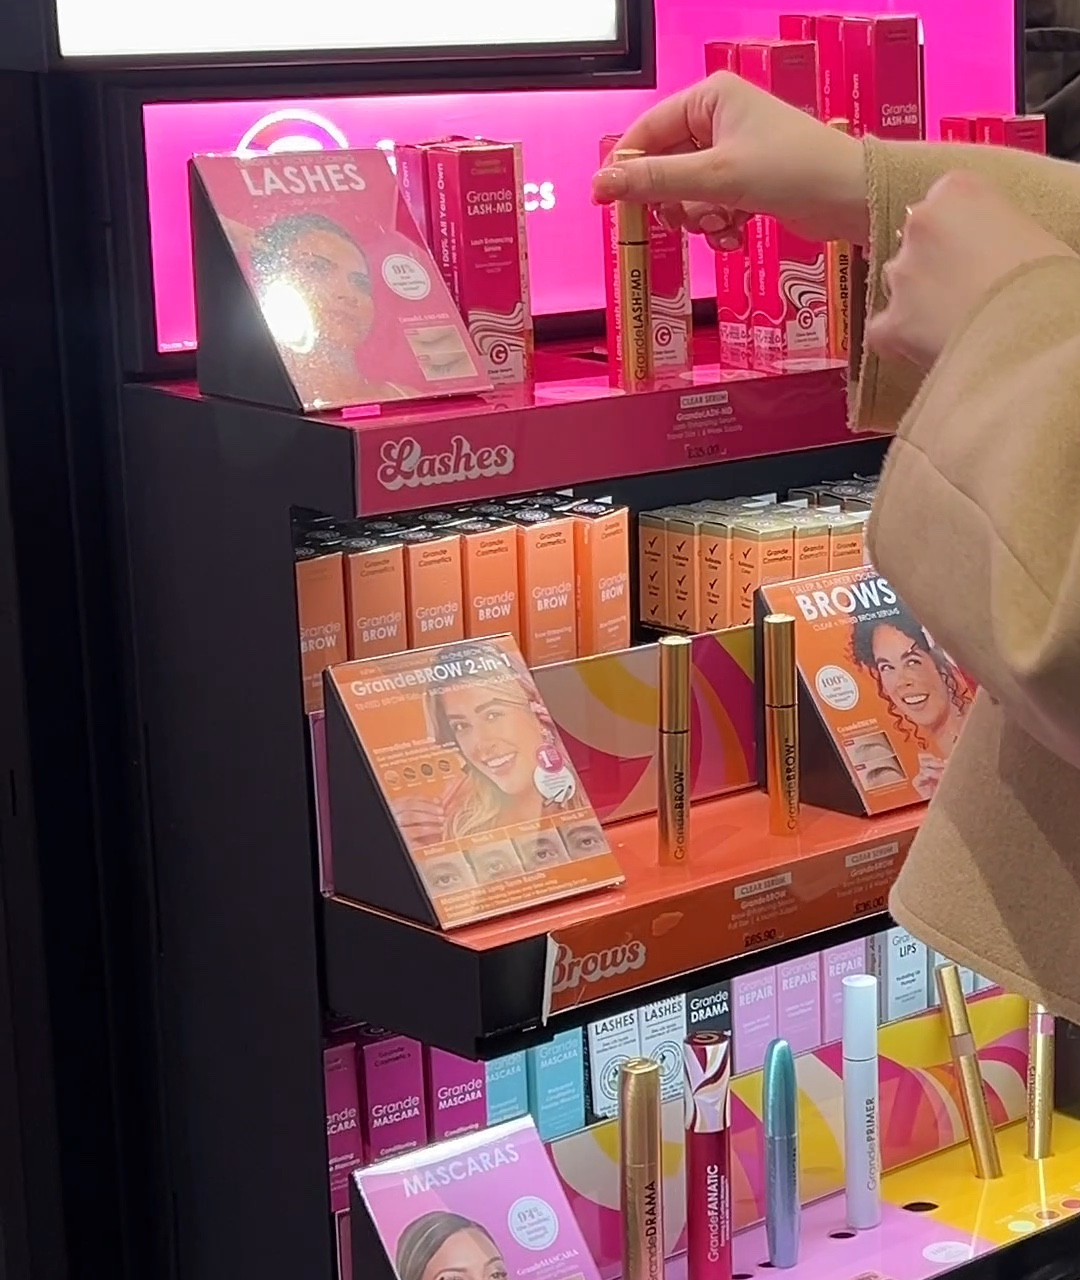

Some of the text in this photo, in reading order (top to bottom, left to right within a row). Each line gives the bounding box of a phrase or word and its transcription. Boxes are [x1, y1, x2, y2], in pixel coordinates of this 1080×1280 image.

[882, 102, 918, 116] Grande
[241, 163, 366, 197] LASHES
[437, 162, 445, 190] Own
[466, 189, 513, 204] Grande
[467, 202, 513, 216] LASH-MD
[378, 436, 513, 488] Lashes
[473, 590, 515, 609] Grande
[532, 581, 572, 599] Grande
[601, 583, 624, 602] BROW
[796, 578, 897, 622] BROWS
[416, 601, 459, 620] Grande
[478, 603, 511, 621] BROW
[537, 594, 568, 612] BROW
[357, 611, 402, 630] Grande
[421, 615, 455, 632] BROW
[363, 624, 398, 642] BROW
[301, 634, 337, 653] BROW
[351, 662, 463, 697] GrandeBROW
[465, 653, 512, 675] 2-in-1
[673, 764, 685, 861] GrandeBROW
[899, 942, 917, 958] LIPS
[829, 957, 863, 977] REPAIR
[782, 970, 818, 990] REPAIR
[690, 990, 729, 1010] Grande
[739, 985, 773, 1007] REPAIR
[645, 1000, 683, 1023] LASHES
[690, 1002, 729, 1023] DRAMA
[594, 1013, 635, 1036] LASHES
[540, 1049, 578, 1068] MASCARA
[437, 1078, 483, 1100] Grande
[371, 1095, 420, 1117] Grande
[438, 1090, 483, 1110] MASCARA
[326, 1108, 357, 1125] ande
[372, 1108, 420, 1129] MASCARA
[866, 1097, 876, 1192] GrandePRIMER
[402, 1143, 520, 1199] MASCARAS
[706, 1164, 720, 1263] GrandeFANATIC
